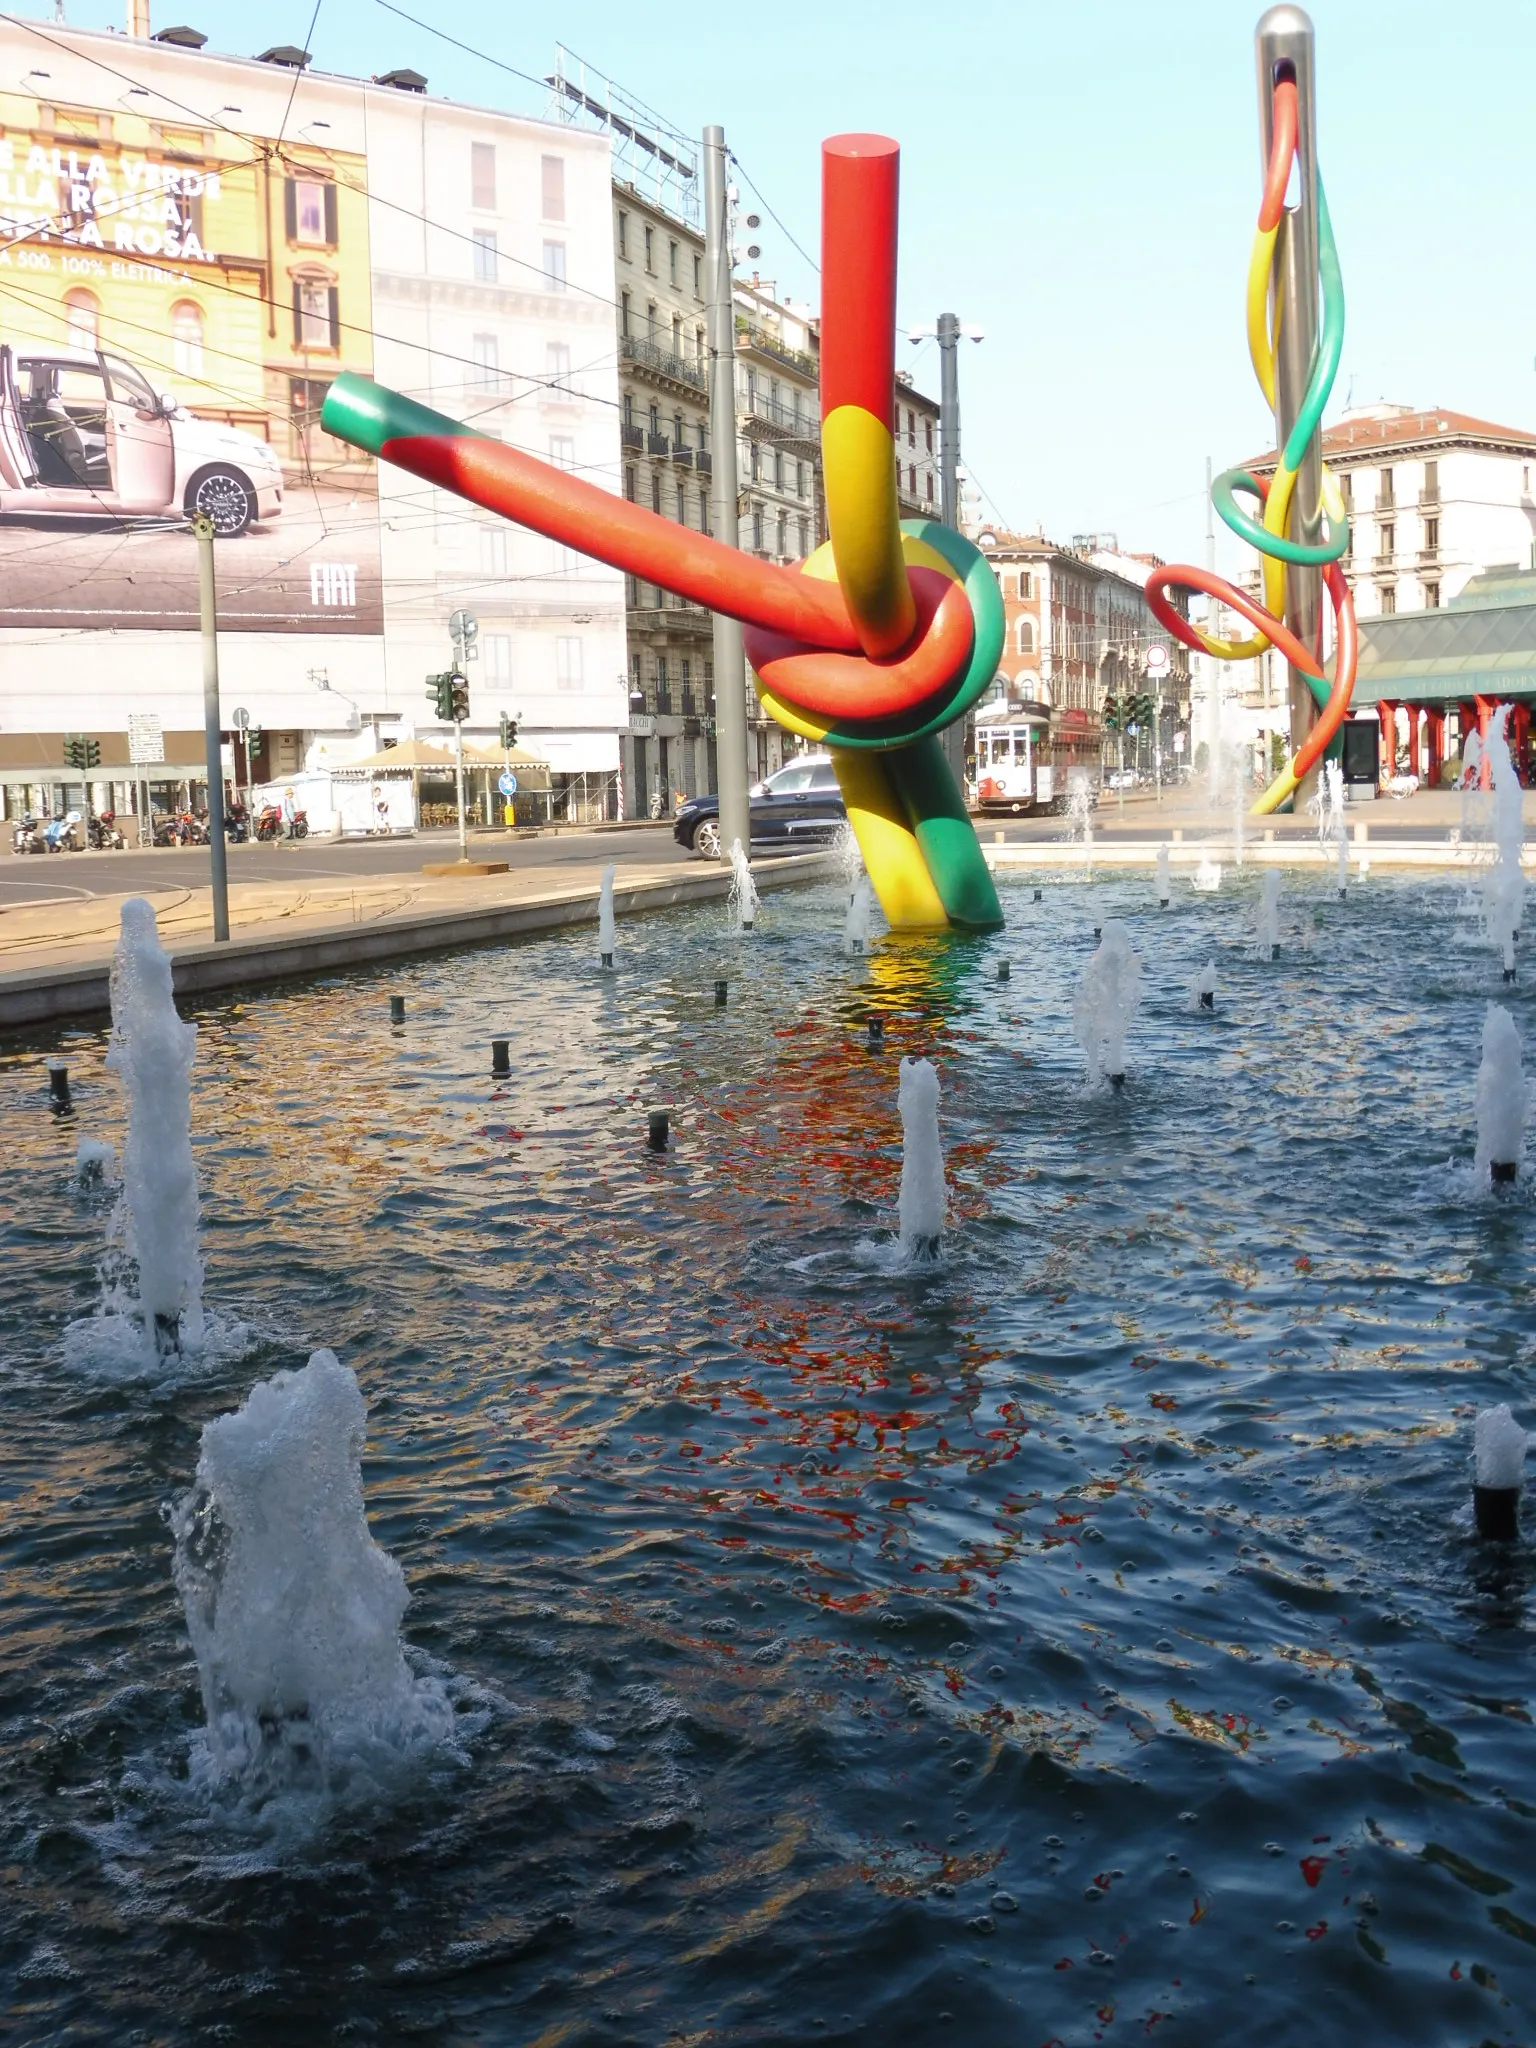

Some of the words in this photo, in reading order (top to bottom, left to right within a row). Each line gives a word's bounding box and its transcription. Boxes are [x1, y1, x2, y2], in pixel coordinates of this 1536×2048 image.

[25, 145, 111, 184] ALLA
[119, 157, 221, 201] VERDE
[71, 184, 193, 231] ROSSA,
[114, 222, 215, 262] ROSA.
[62, 256, 106, 276] 100%
[310, 563, 358, 606] FIAT
